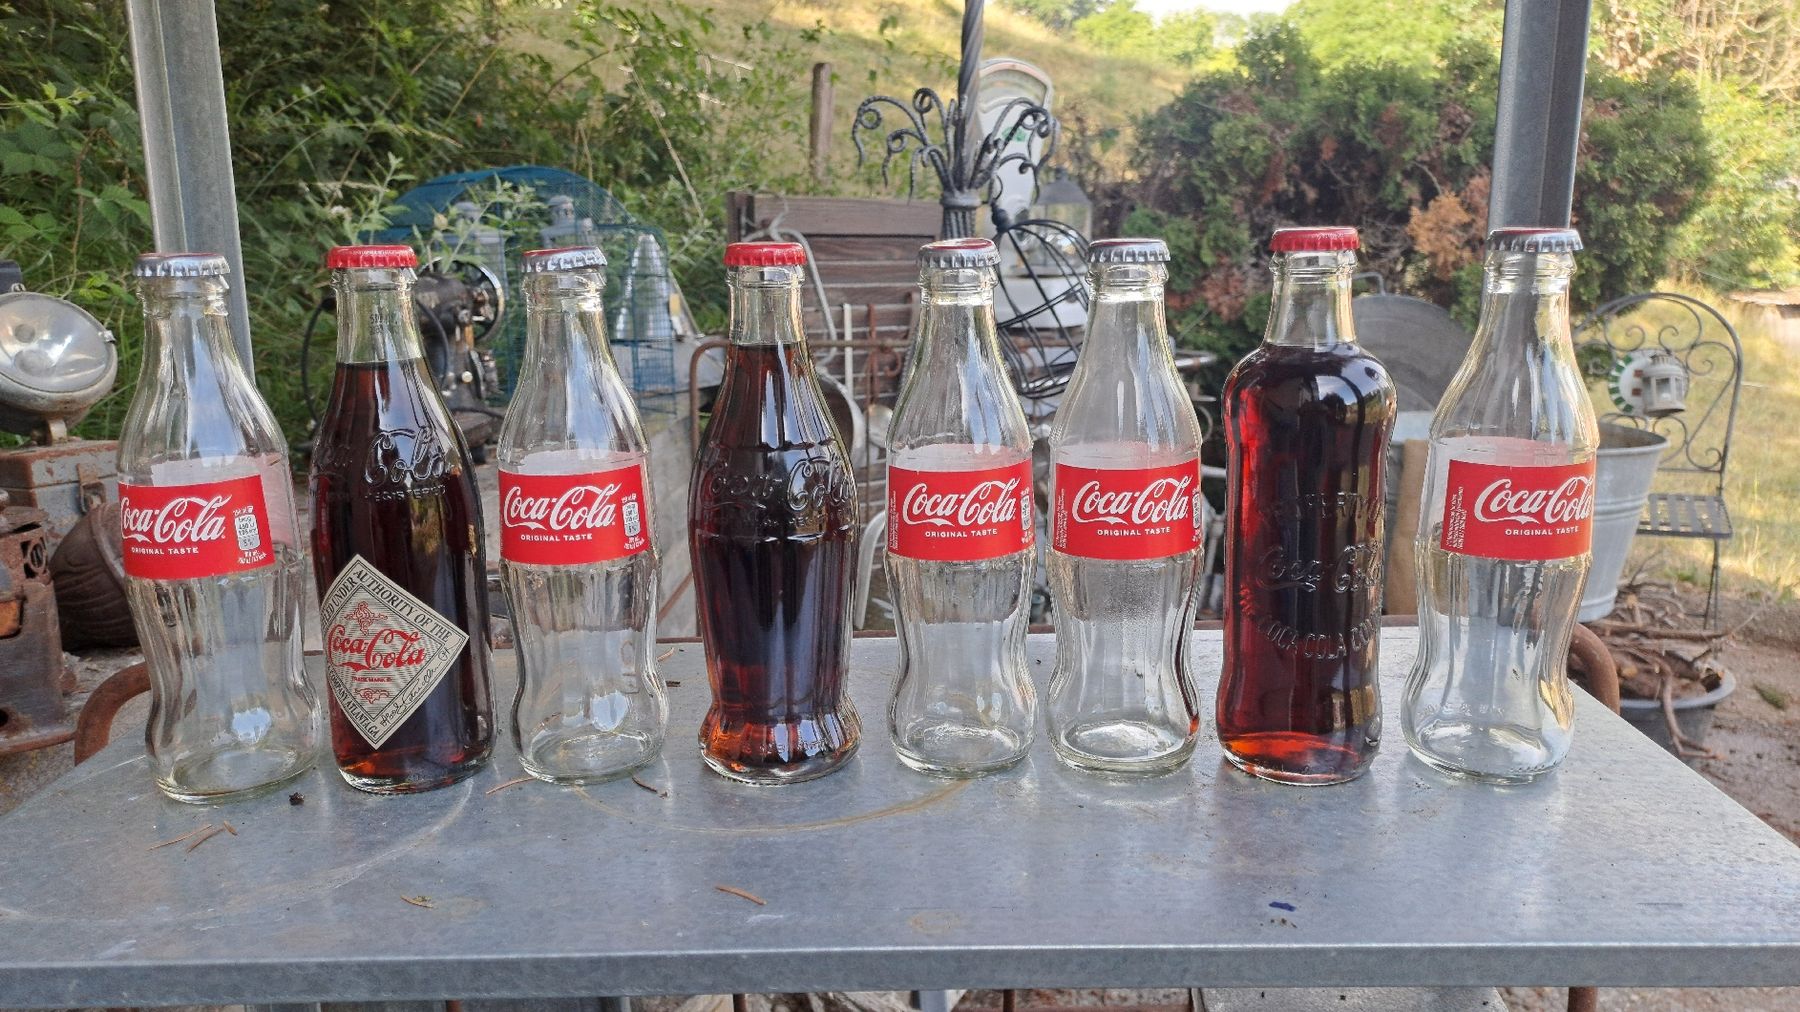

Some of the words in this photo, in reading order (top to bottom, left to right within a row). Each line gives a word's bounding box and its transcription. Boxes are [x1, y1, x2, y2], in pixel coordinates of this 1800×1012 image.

[121, 494, 232, 543] Coca-Cola
[504, 483, 622, 530] Coca-Cola
[902, 477, 1021, 526] Coca-Cola
[1072, 475, 1192, 525] Coca-Cola
[131, 546, 164, 555] ORIGINAL
[168, 547, 199, 555] TASTE
[520, 534, 560, 542] ORIGINAL
[563, 533, 593, 541] TASTE
[925, 530, 967, 538] ORIGINAL
[971, 528, 998, 537] TASTE
[1097, 528, 1141, 537] ORIGINAL
[1145, 527, 1170, 535] TASTE
[1505, 528, 1552, 536] ORIGINAL
[1556, 526, 1579, 534] TASTE
[331, 577, 358, 608] UNDER
[353, 569, 418, 617] AUTHORITY
[413, 613, 433, 628] OF
[428, 625, 453, 643] THE
[328, 624, 425, 672] Coca-Cola
